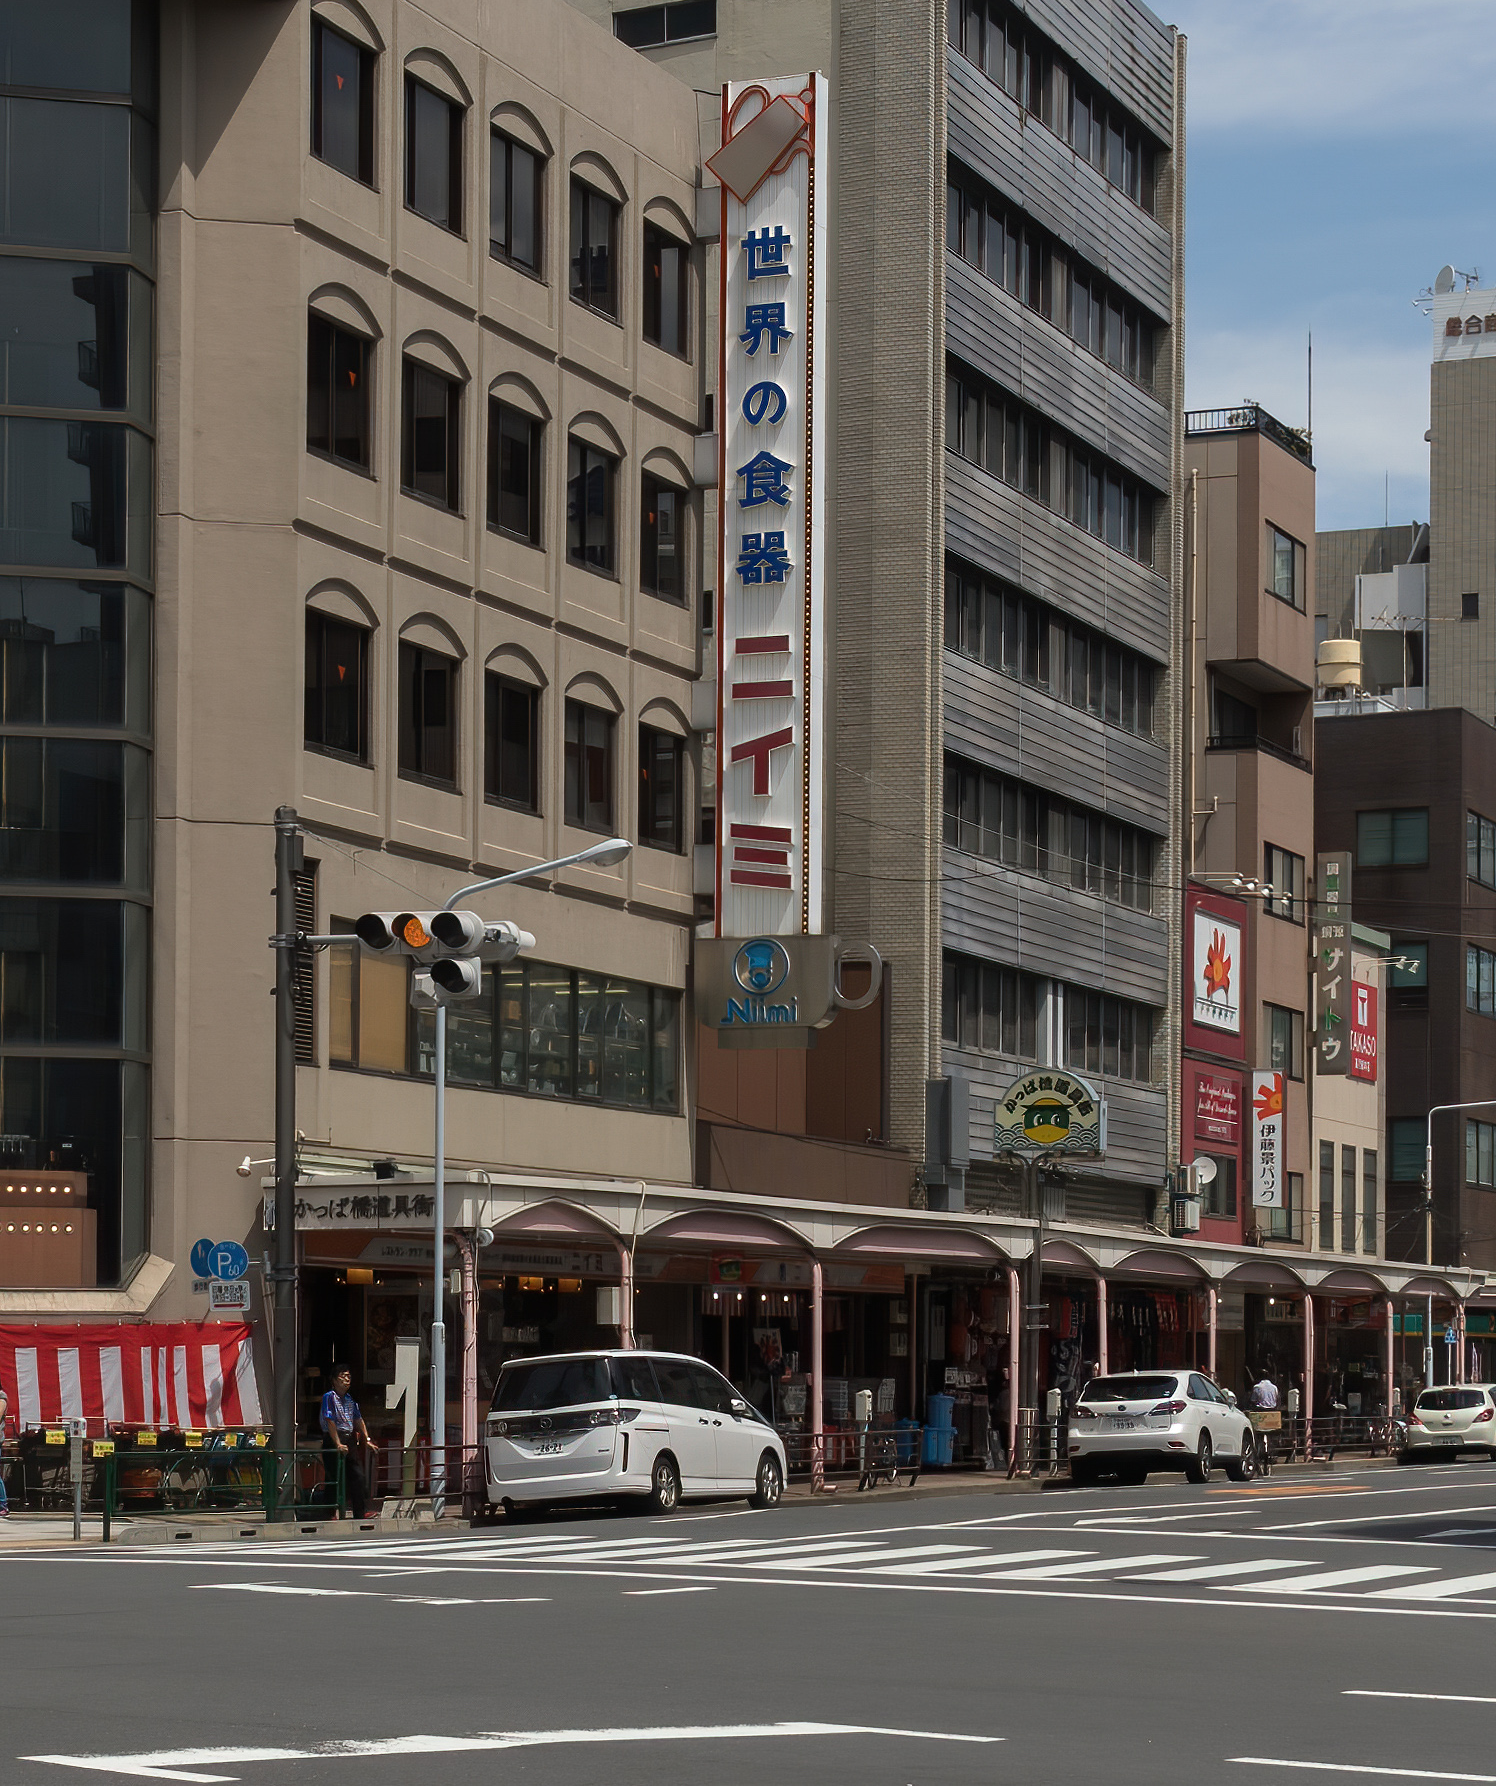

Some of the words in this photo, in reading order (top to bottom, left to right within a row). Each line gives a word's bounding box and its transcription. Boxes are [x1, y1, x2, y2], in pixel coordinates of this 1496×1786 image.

[736, 224, 794, 587] 世界の食器
[730, 634, 794, 890] ニイミ
[720, 996, 799, 1025] Niimi
[217, 1252, 232, 1276] P
[228, 1264, 240, 1276] 60
